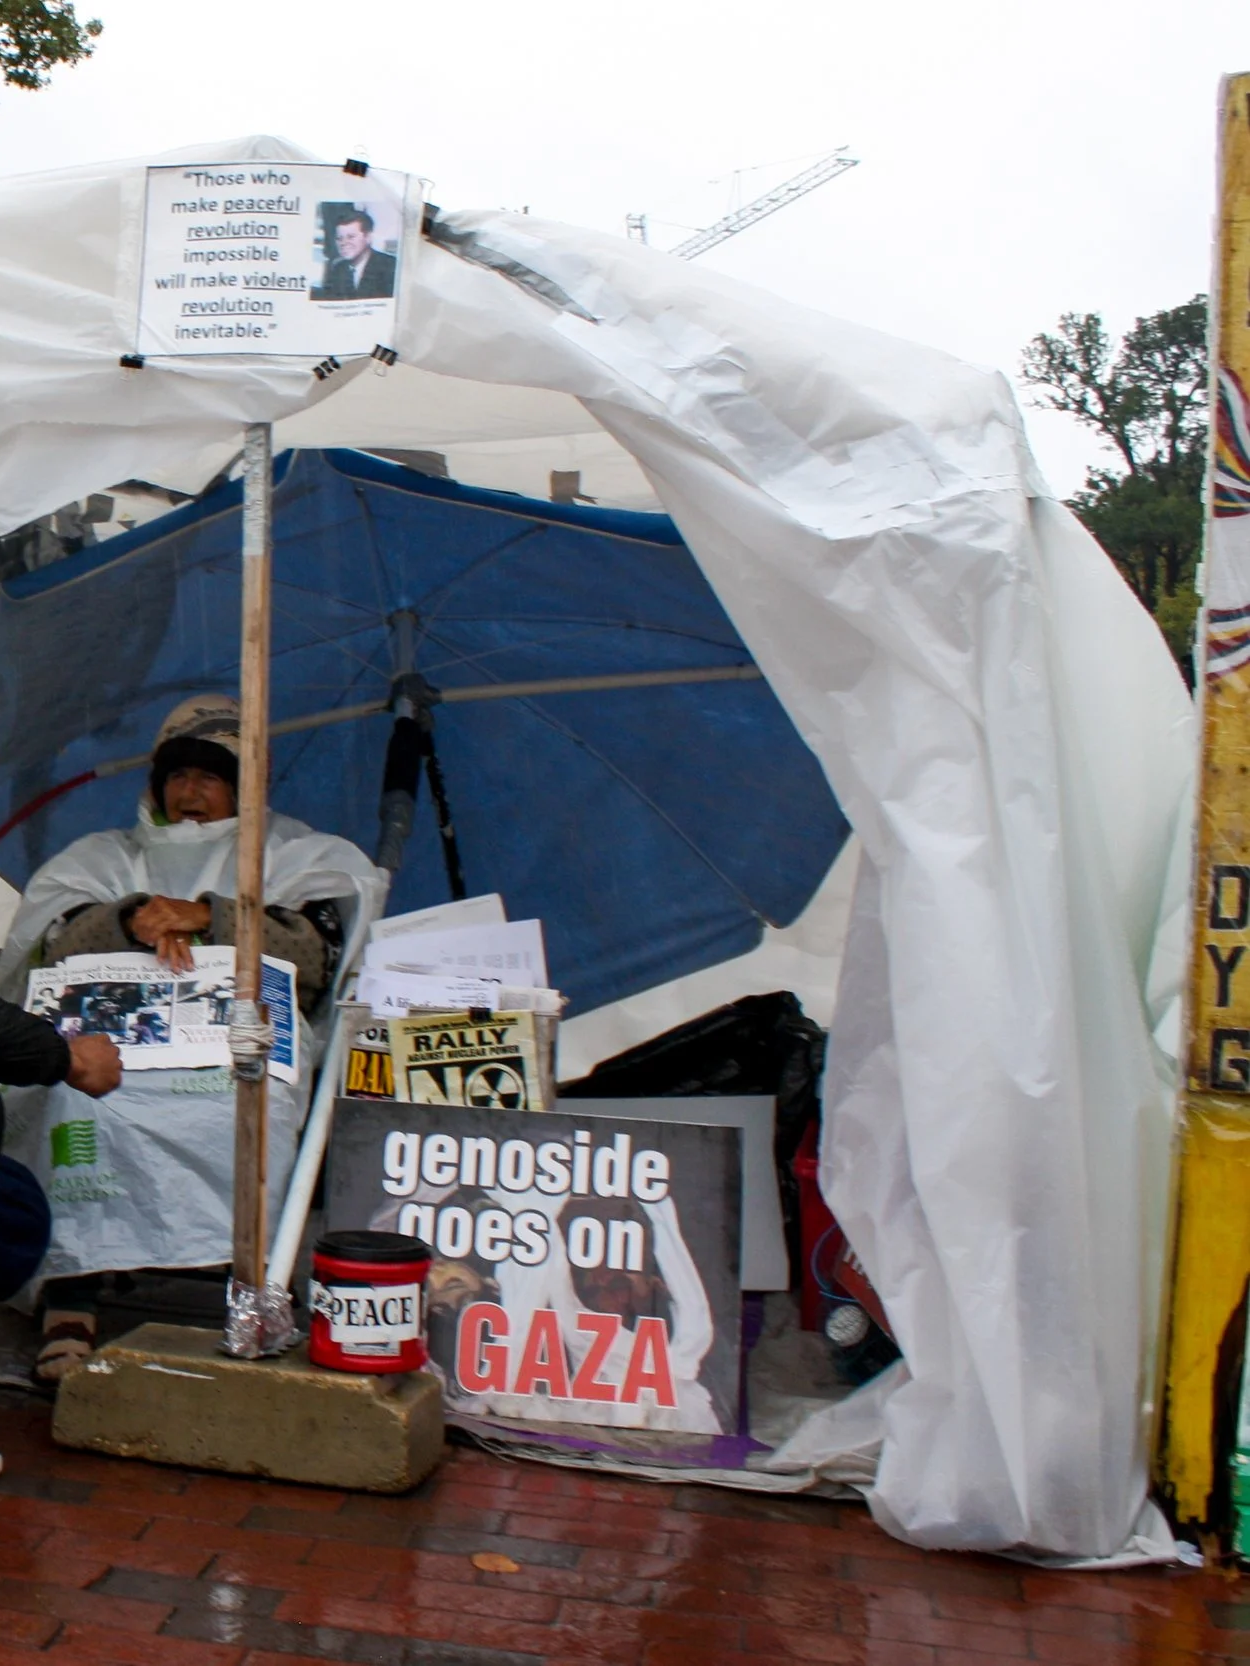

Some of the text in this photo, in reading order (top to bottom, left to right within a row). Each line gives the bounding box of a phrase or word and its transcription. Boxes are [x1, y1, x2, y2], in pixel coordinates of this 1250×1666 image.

[250, 168, 290, 185] who
[171, 196, 301, 215] make peaceful
[187, 222, 279, 241] revolution
[183, 246, 279, 264] impossible
[155, 271, 306, 290] will make violent
[181, 299, 273, 316] revolution
[413, 1028, 508, 1052] RALLY
[407, 1045, 520, 1063] AGAINST NUCLEAR POWER
[382, 1129, 669, 1200] genoside
[397, 1202, 643, 1272] goes on
[332, 1296, 413, 1326] PEACE
[456, 1301, 679, 1409] GAZA
